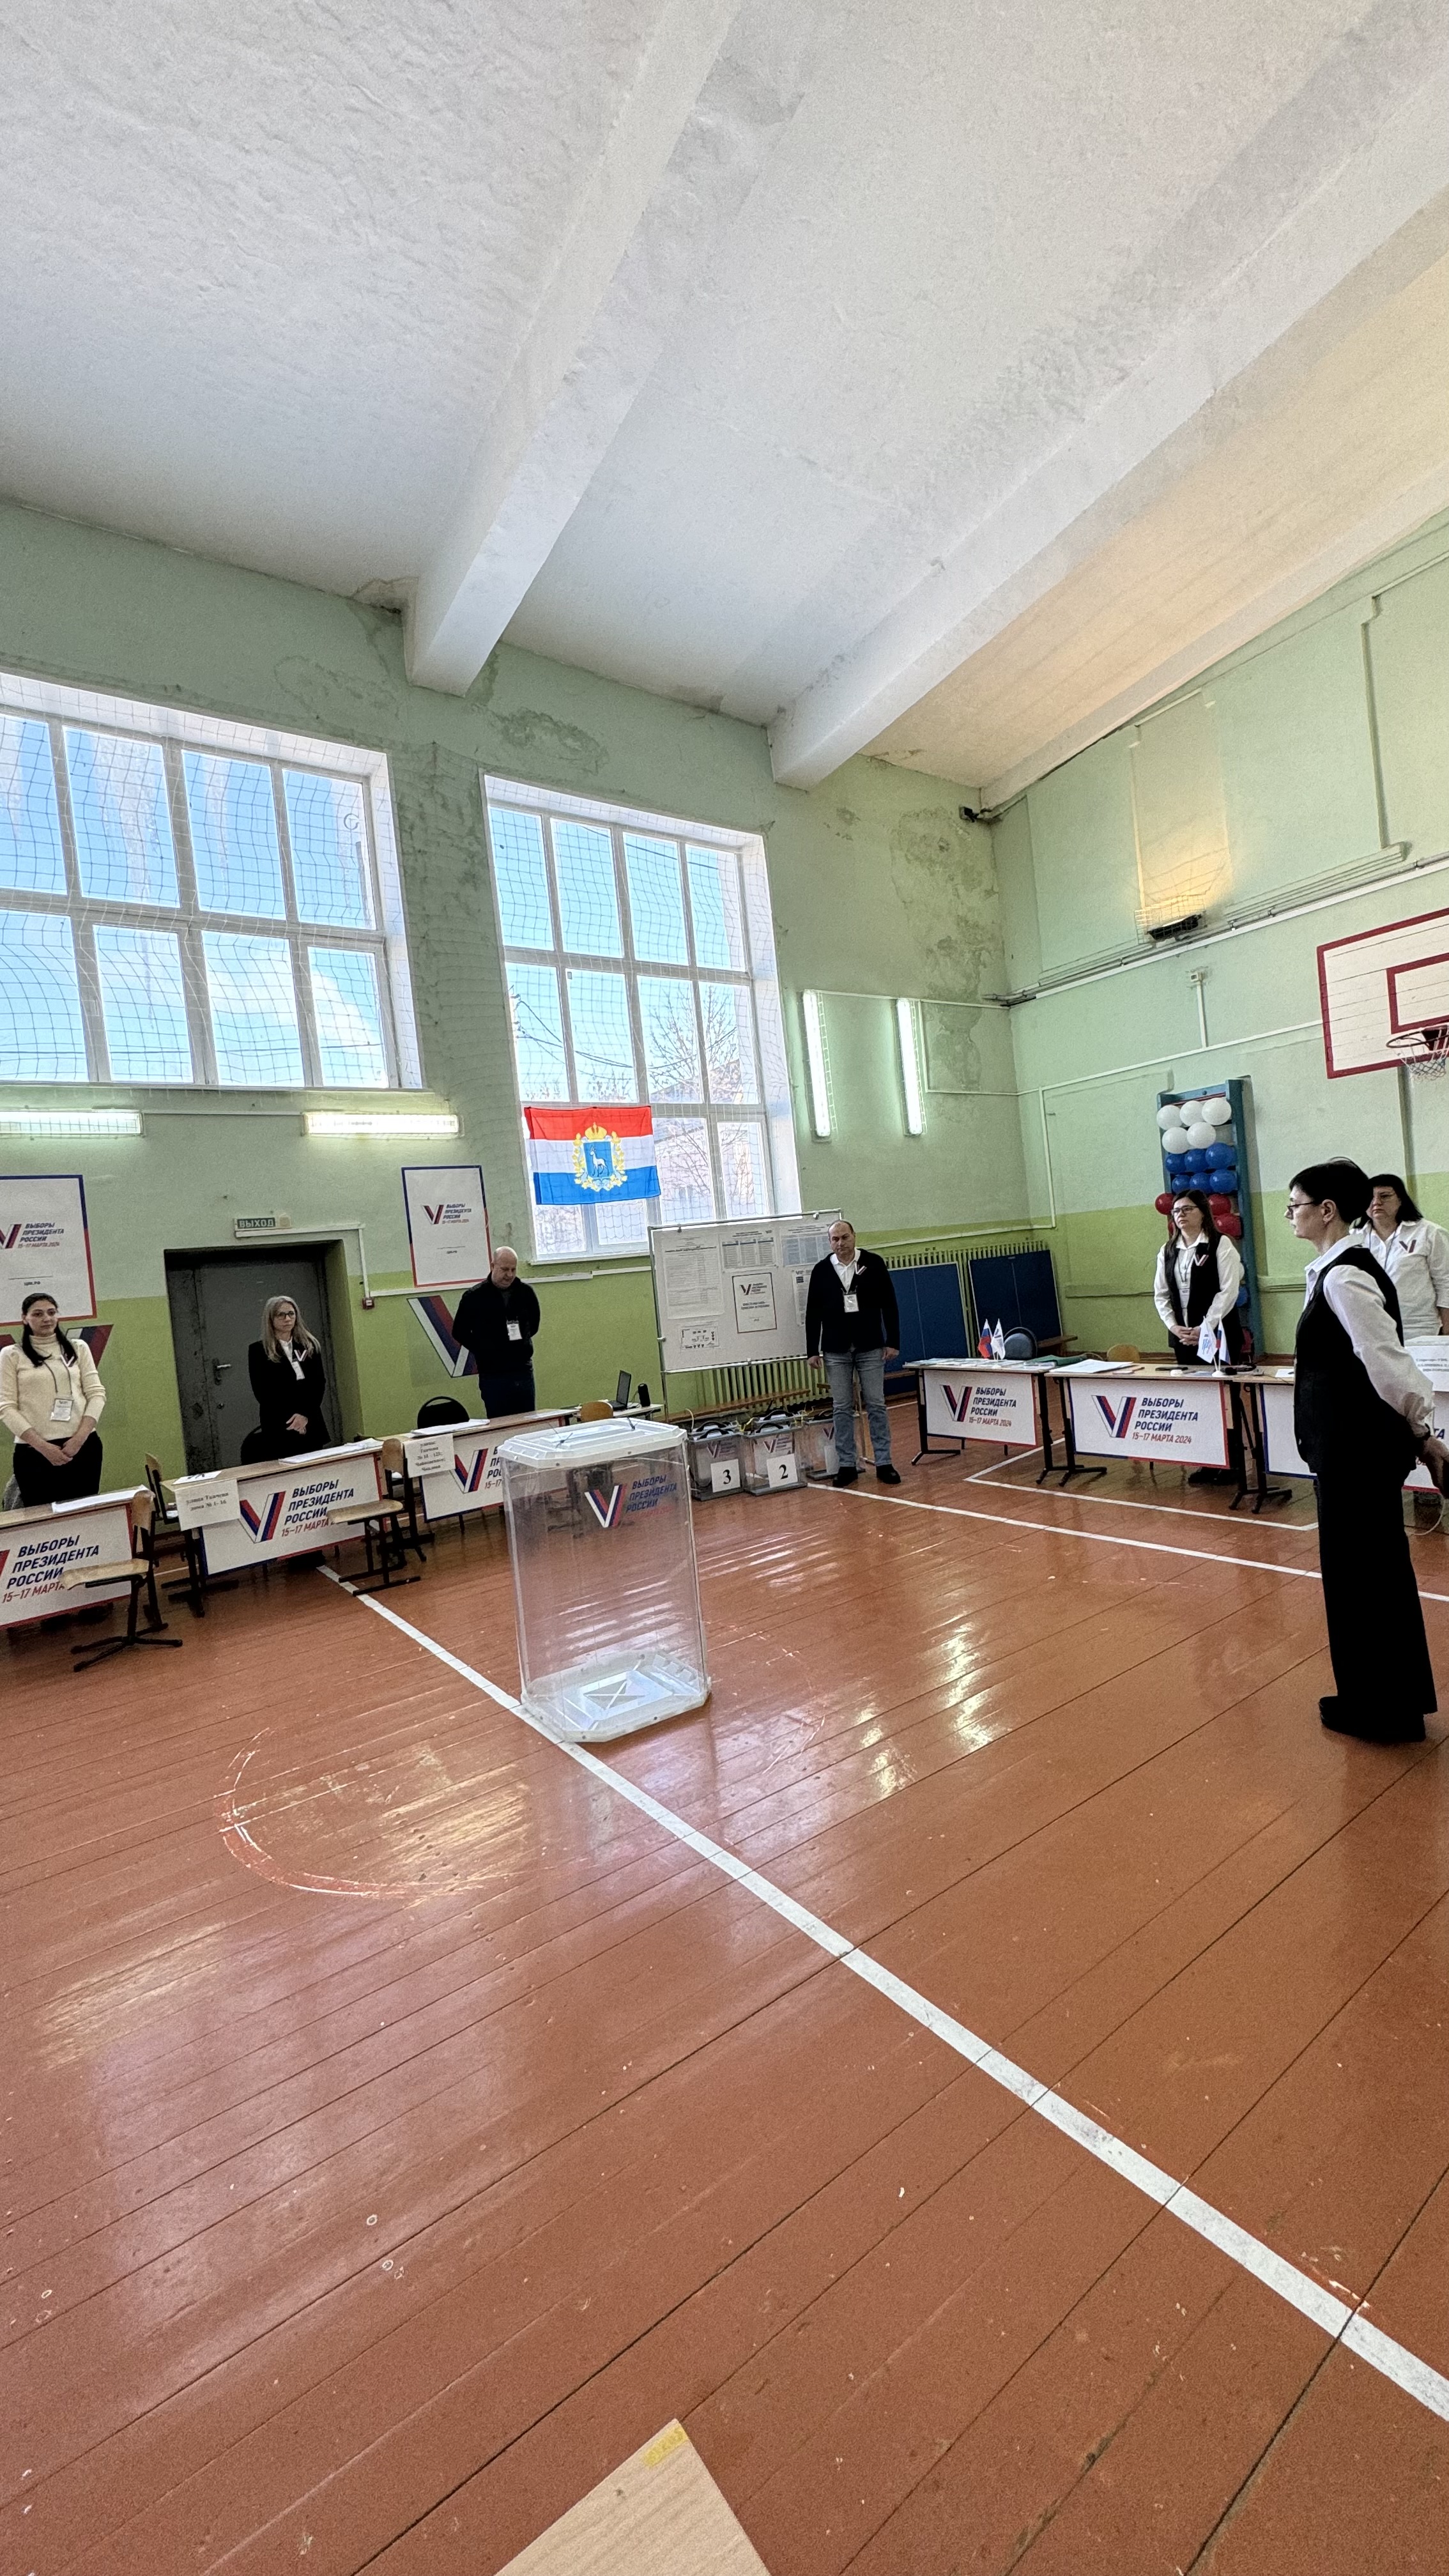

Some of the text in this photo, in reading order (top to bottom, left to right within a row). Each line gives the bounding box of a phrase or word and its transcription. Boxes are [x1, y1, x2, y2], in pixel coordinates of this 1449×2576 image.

[239, 1219, 274, 1227] ВЫХОД
[976, 1387, 1006, 1396] ВЫБОРЫ
[972, 1397, 1016, 1407] ПРЕЗИДЕНТА
[1142, 1397, 1184, 1408] ВЫБОРЫ
[970, 1407, 998, 1416] РОССИИ
[1138, 1409, 1199, 1422] ПРЕЗИДЕНТА
[1135, 1421, 1172, 1432] РОССИИ
[1151, 1434, 1174, 1443] МАРТА
[1175, 1436, 1192, 1444] 2024
[723, 1469, 732, 1485] 3
[779, 1464, 788, 1480] 2
[292, 1479, 339, 1498] ВЫБОРЫ
[632, 1475, 667, 1490] ВЫБОРЫ
[629, 1483, 677, 1501] ПРЕЗИДЕНТА
[288, 1488, 354, 1512] ПРЕЗИДЕНТА
[626, 1498, 659, 1514] РОССИИ
[284, 1506, 328, 1525] РОССИИ
[303, 1518, 329, 1532] МАРТА
[18, 1535, 80, 1558] ВЫБОРЫ
[12, 1545, 99, 1574] ПРЕЗИДЕНТА
[6, 1567, 64, 1589] РОССИИ
